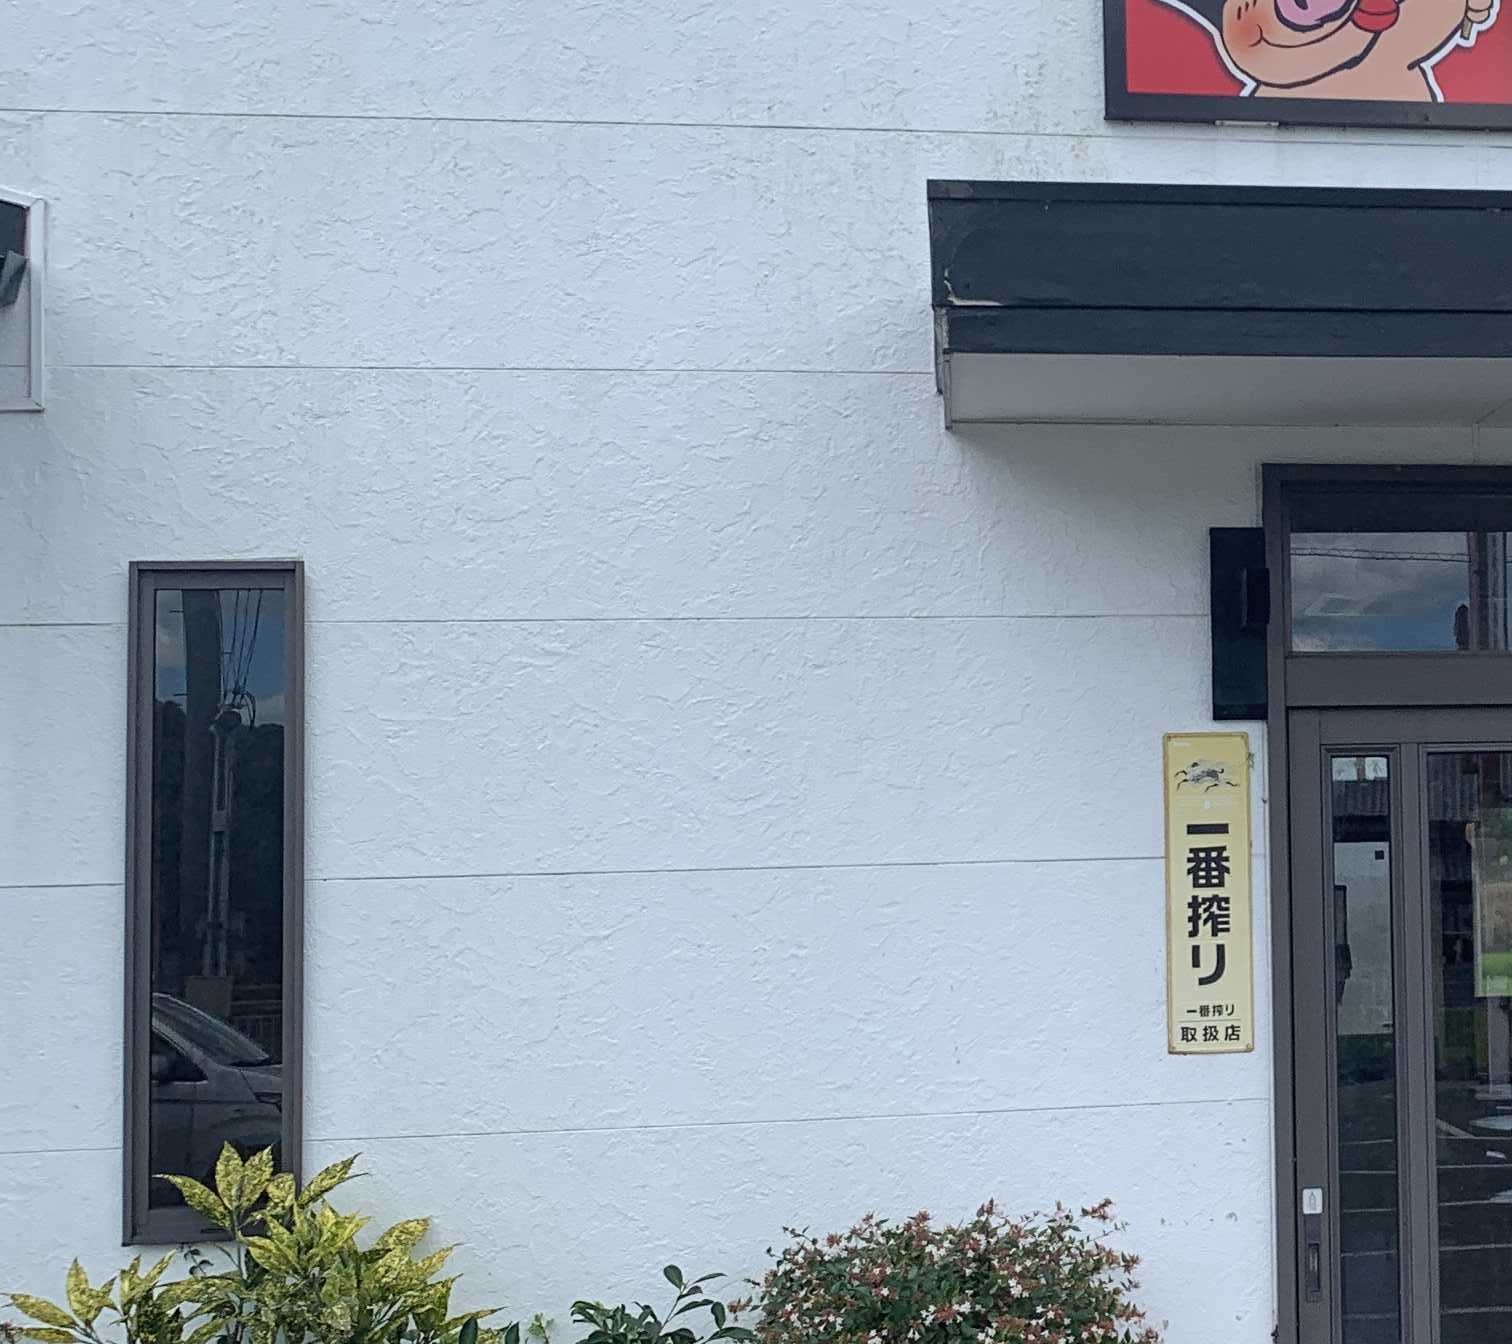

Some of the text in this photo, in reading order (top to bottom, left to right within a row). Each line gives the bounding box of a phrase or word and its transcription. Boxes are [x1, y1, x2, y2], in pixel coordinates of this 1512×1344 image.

[1186, 822, 1231, 986] 一番搾り
[1186, 1004, 1235, 1017] 一番搾り
[1180, 1024, 1241, 1043] 取扱店
